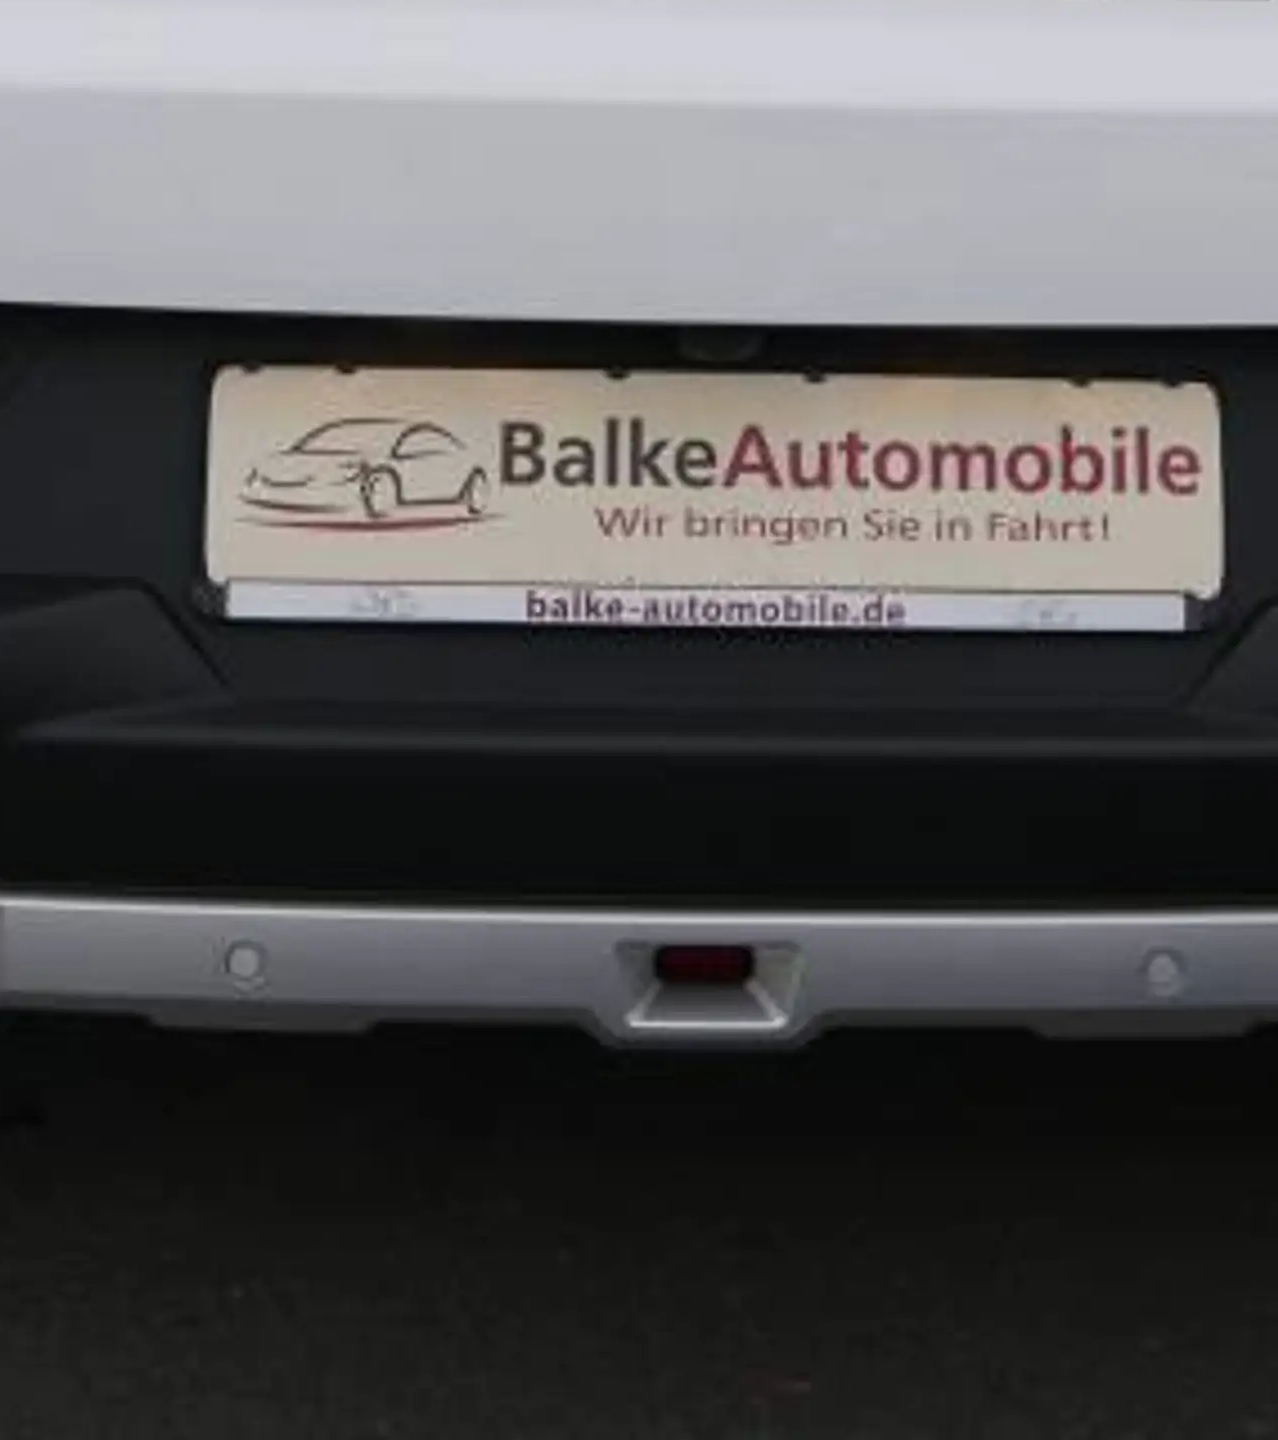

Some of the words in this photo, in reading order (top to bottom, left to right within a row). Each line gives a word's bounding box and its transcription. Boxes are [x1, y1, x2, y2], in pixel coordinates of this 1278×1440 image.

[499, 417, 1202, 494] BalkeAutomobile
[595, 507, 666, 538] Wir
[684, 509, 848, 546] bringen
[864, 510, 922, 542] Sie
[934, 511, 973, 542] in
[987, 512, 1111, 543] Fahrt!
[525, 590, 907, 624] balke-automobile.de
